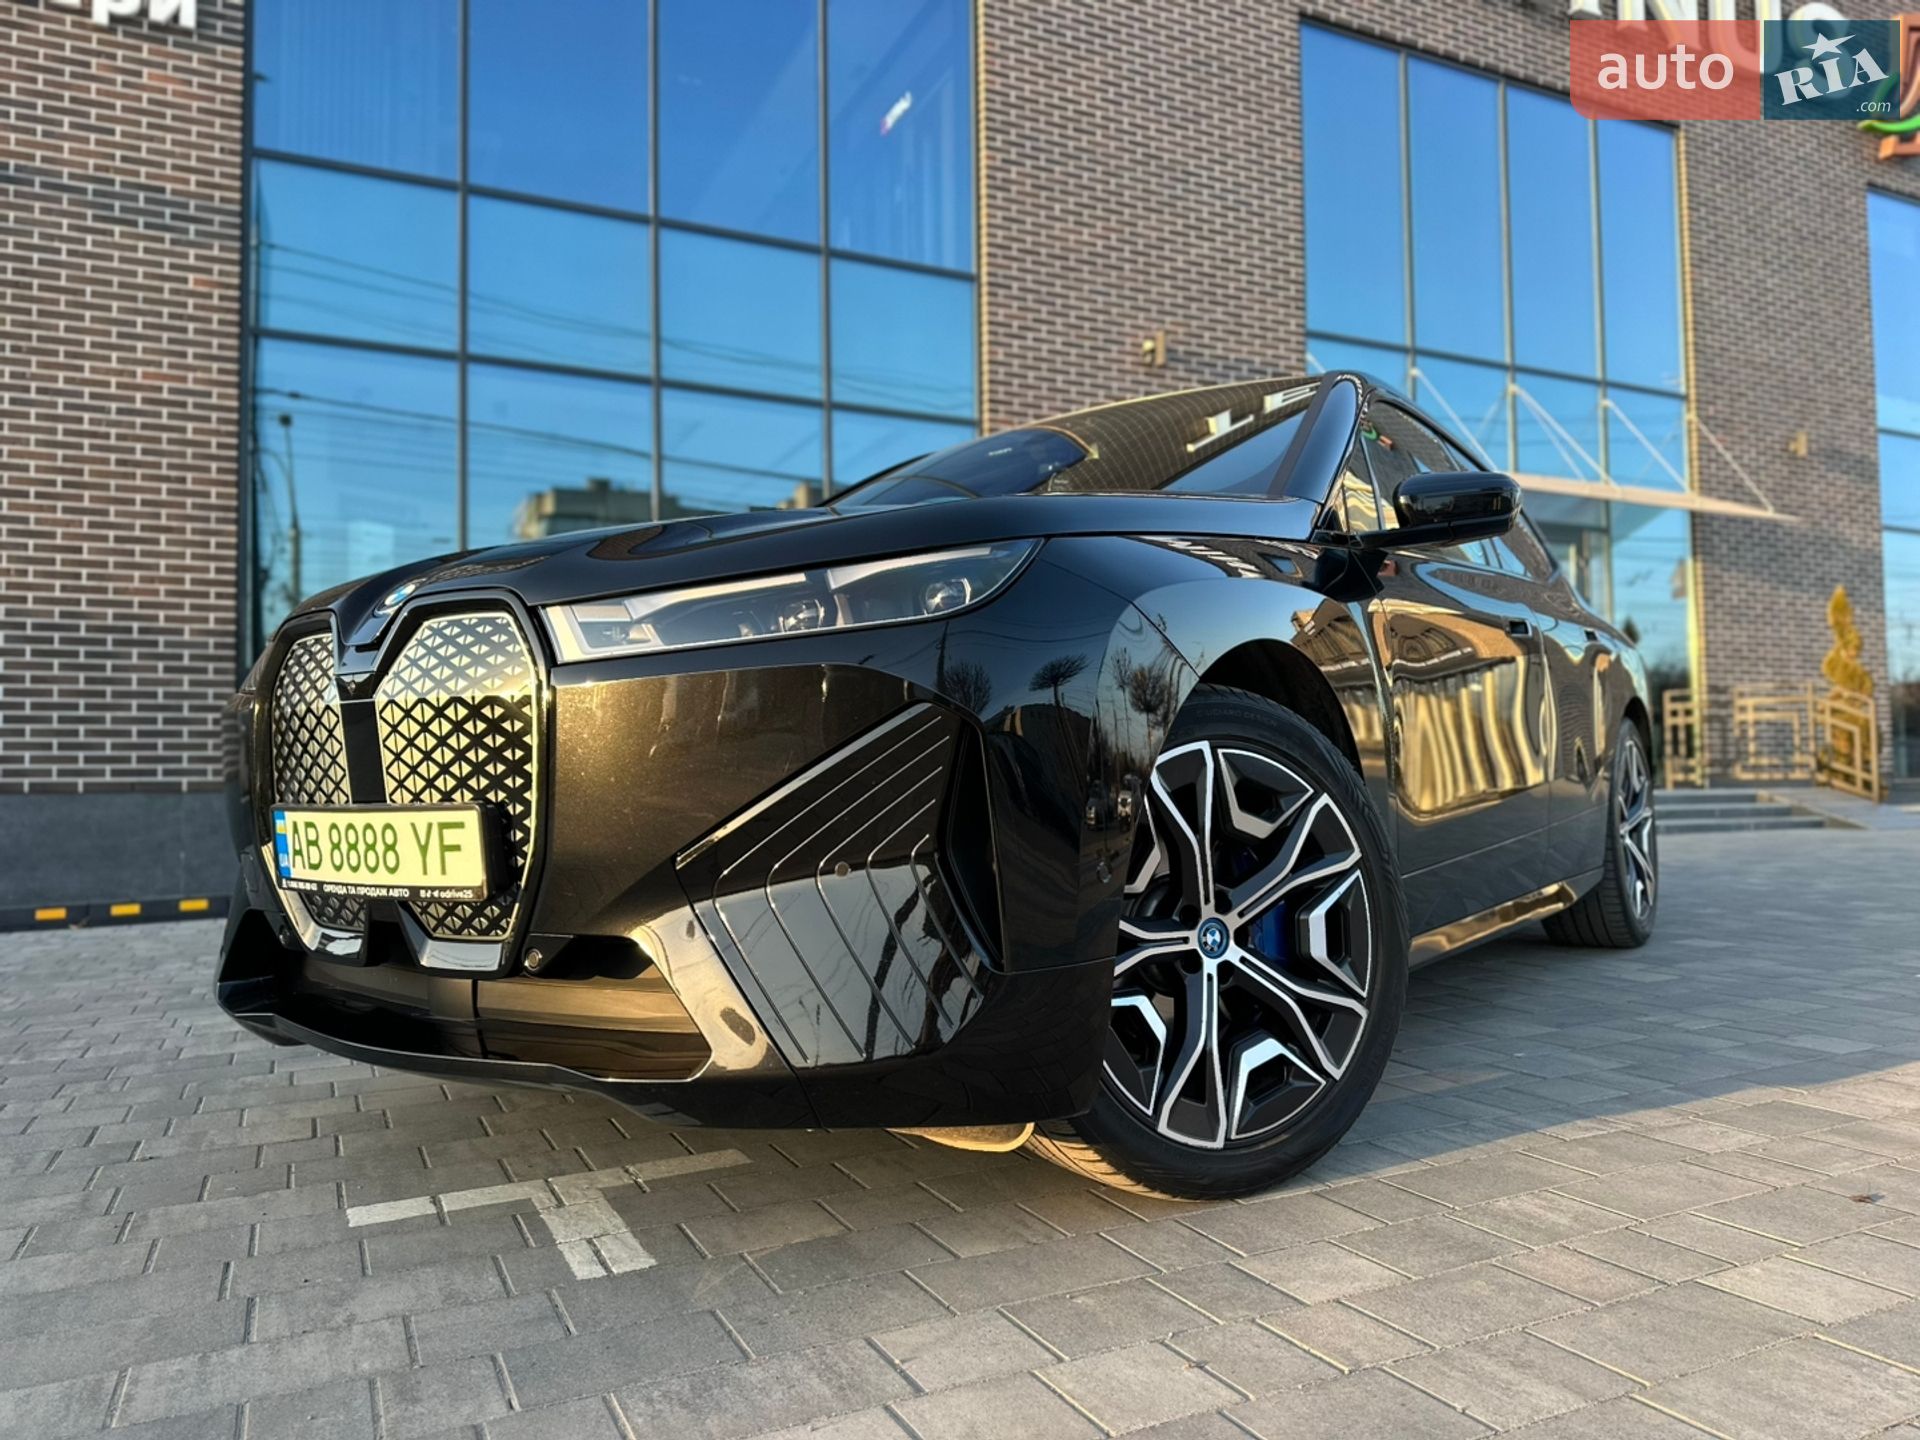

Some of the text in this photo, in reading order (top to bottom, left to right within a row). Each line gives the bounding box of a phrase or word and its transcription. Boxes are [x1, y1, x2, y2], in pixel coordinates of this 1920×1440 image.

[292, 821, 465, 876] AB 8888 YF
